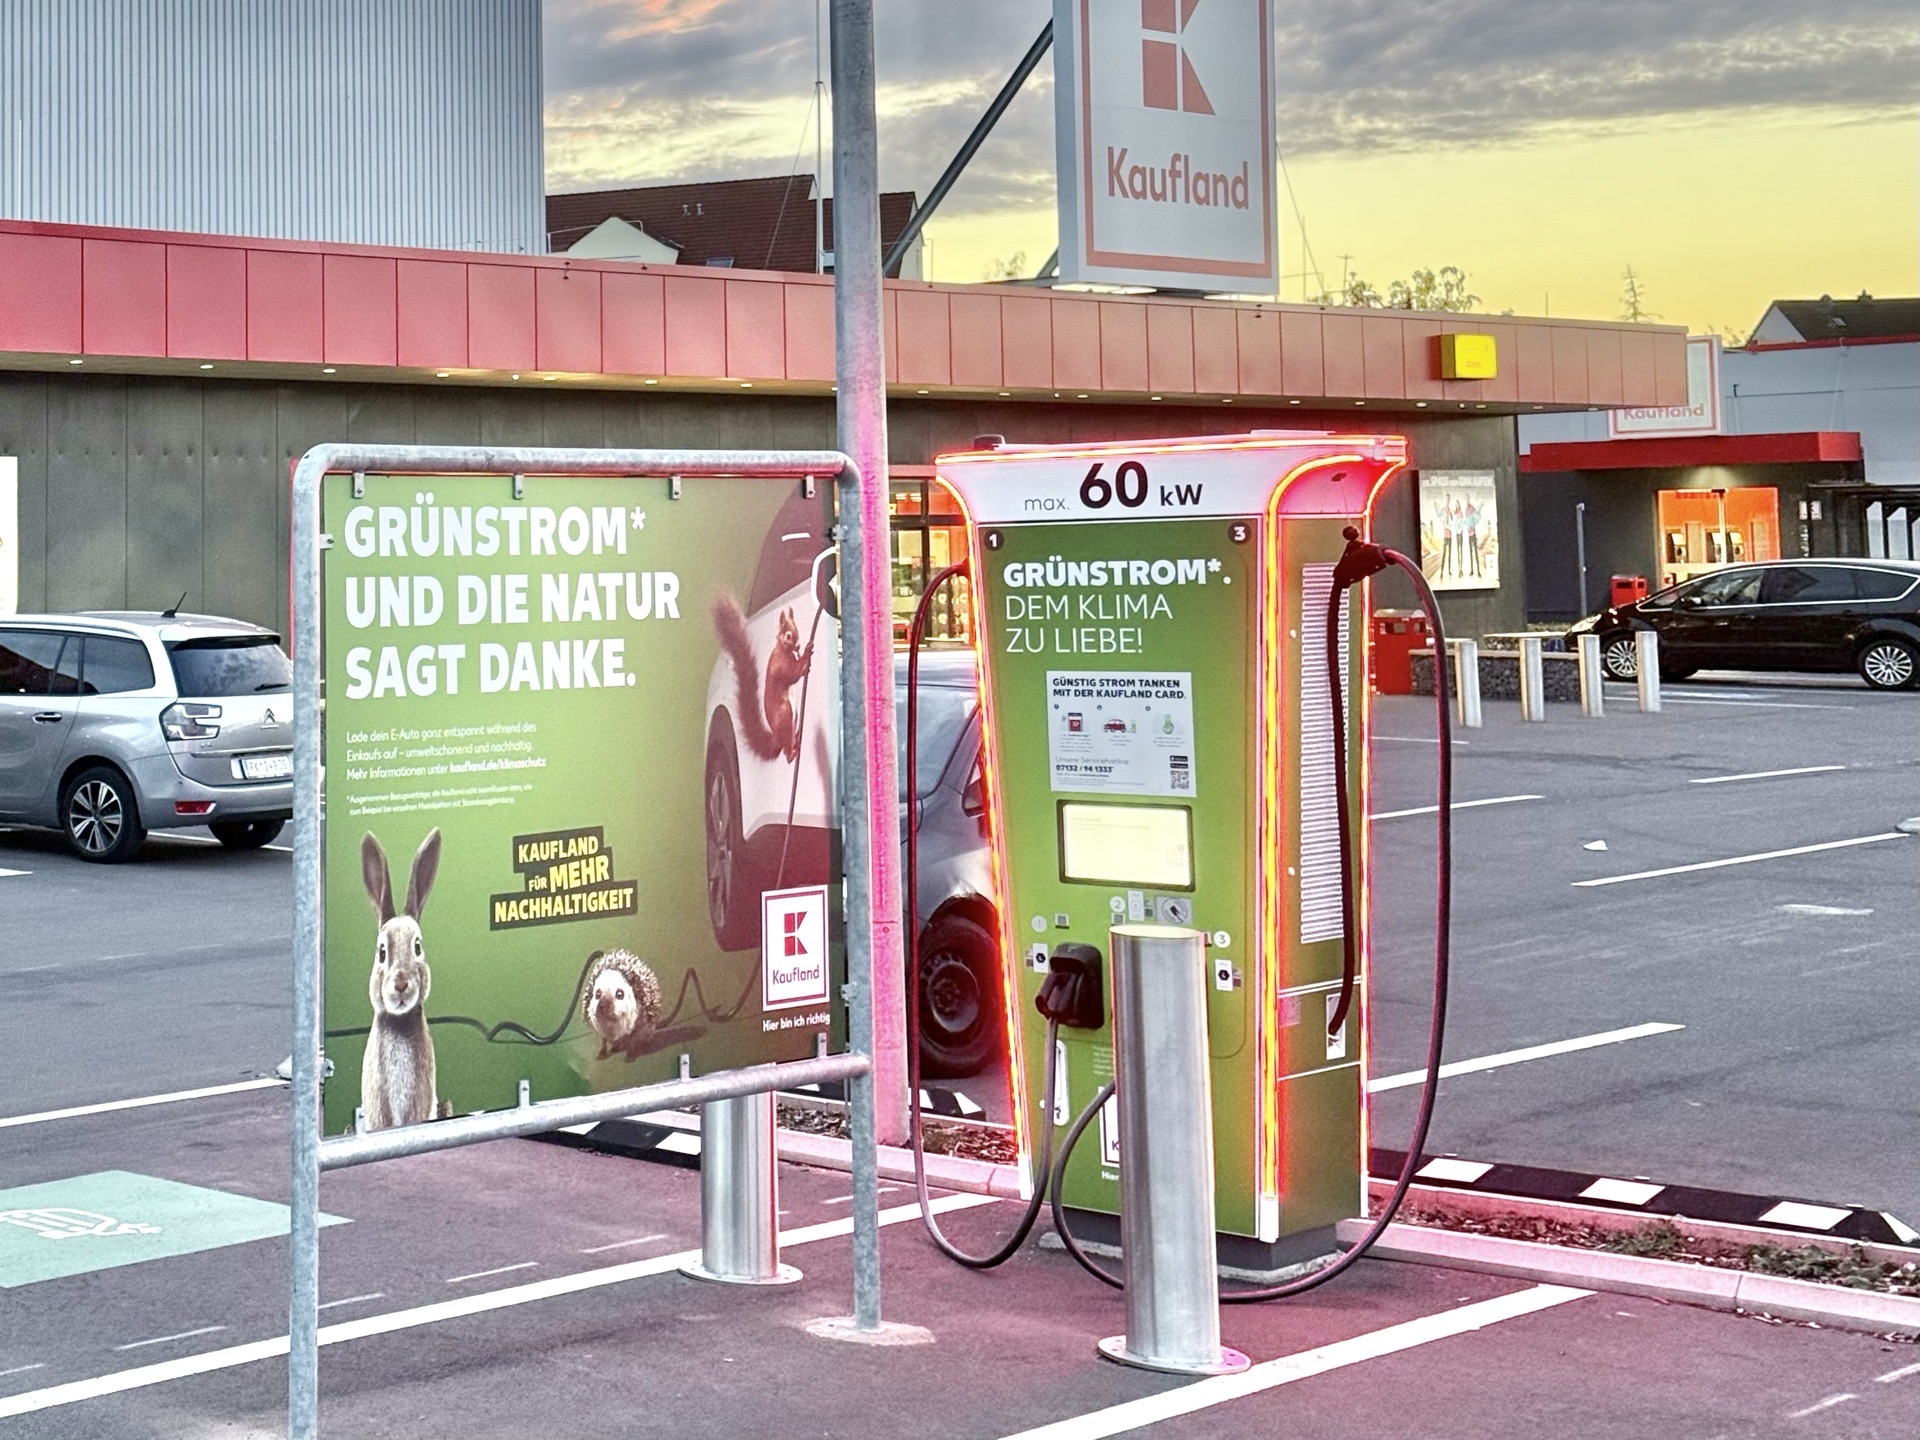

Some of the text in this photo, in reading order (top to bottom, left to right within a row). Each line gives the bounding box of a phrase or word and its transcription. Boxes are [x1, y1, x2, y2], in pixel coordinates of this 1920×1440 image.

[1107, 146, 1249, 210] Kaufland
[1024, 460, 1203, 512] max. 60 kW
[988, 533, 998, 547] 1
[1234, 525, 1247, 541] 3
[344, 571, 681, 629] UND DIE NATUR
[1005, 593, 1174, 620] DEM KLIMA
[1005, 627, 1143, 654] ZU LIEBE!
[345, 637, 637, 700] SAGT DANKE.
[1052, 676, 1180, 689] GÜNSTIG STROM TANKEN
[1052, 689, 1187, 700] MIT DER KAUFLAND CARD.
[346, 721, 537, 743] Lade dein E-Auto ganz entspannt während des
[346, 748, 382, 762] Einkaufs
[382, 746, 398, 760] auf
[405, 743, 473, 758] umweltschonend
[473, 742, 490, 754] und
[346, 756, 547, 781] Mehr Informationen unter kaufland.de/klimaschutz
[517, 835, 600, 864] KAUFLAND
[527, 855, 610, 894] FÜR MEHR
[494, 887, 635, 924] NACHHALTIGKEIT
[1114, 900, 1122, 909] 2
[1218, 935, 1226, 944] 3
[771, 964, 821, 986] Kaufland
[762, 1012, 831, 1033] Hier bin ich richtig
